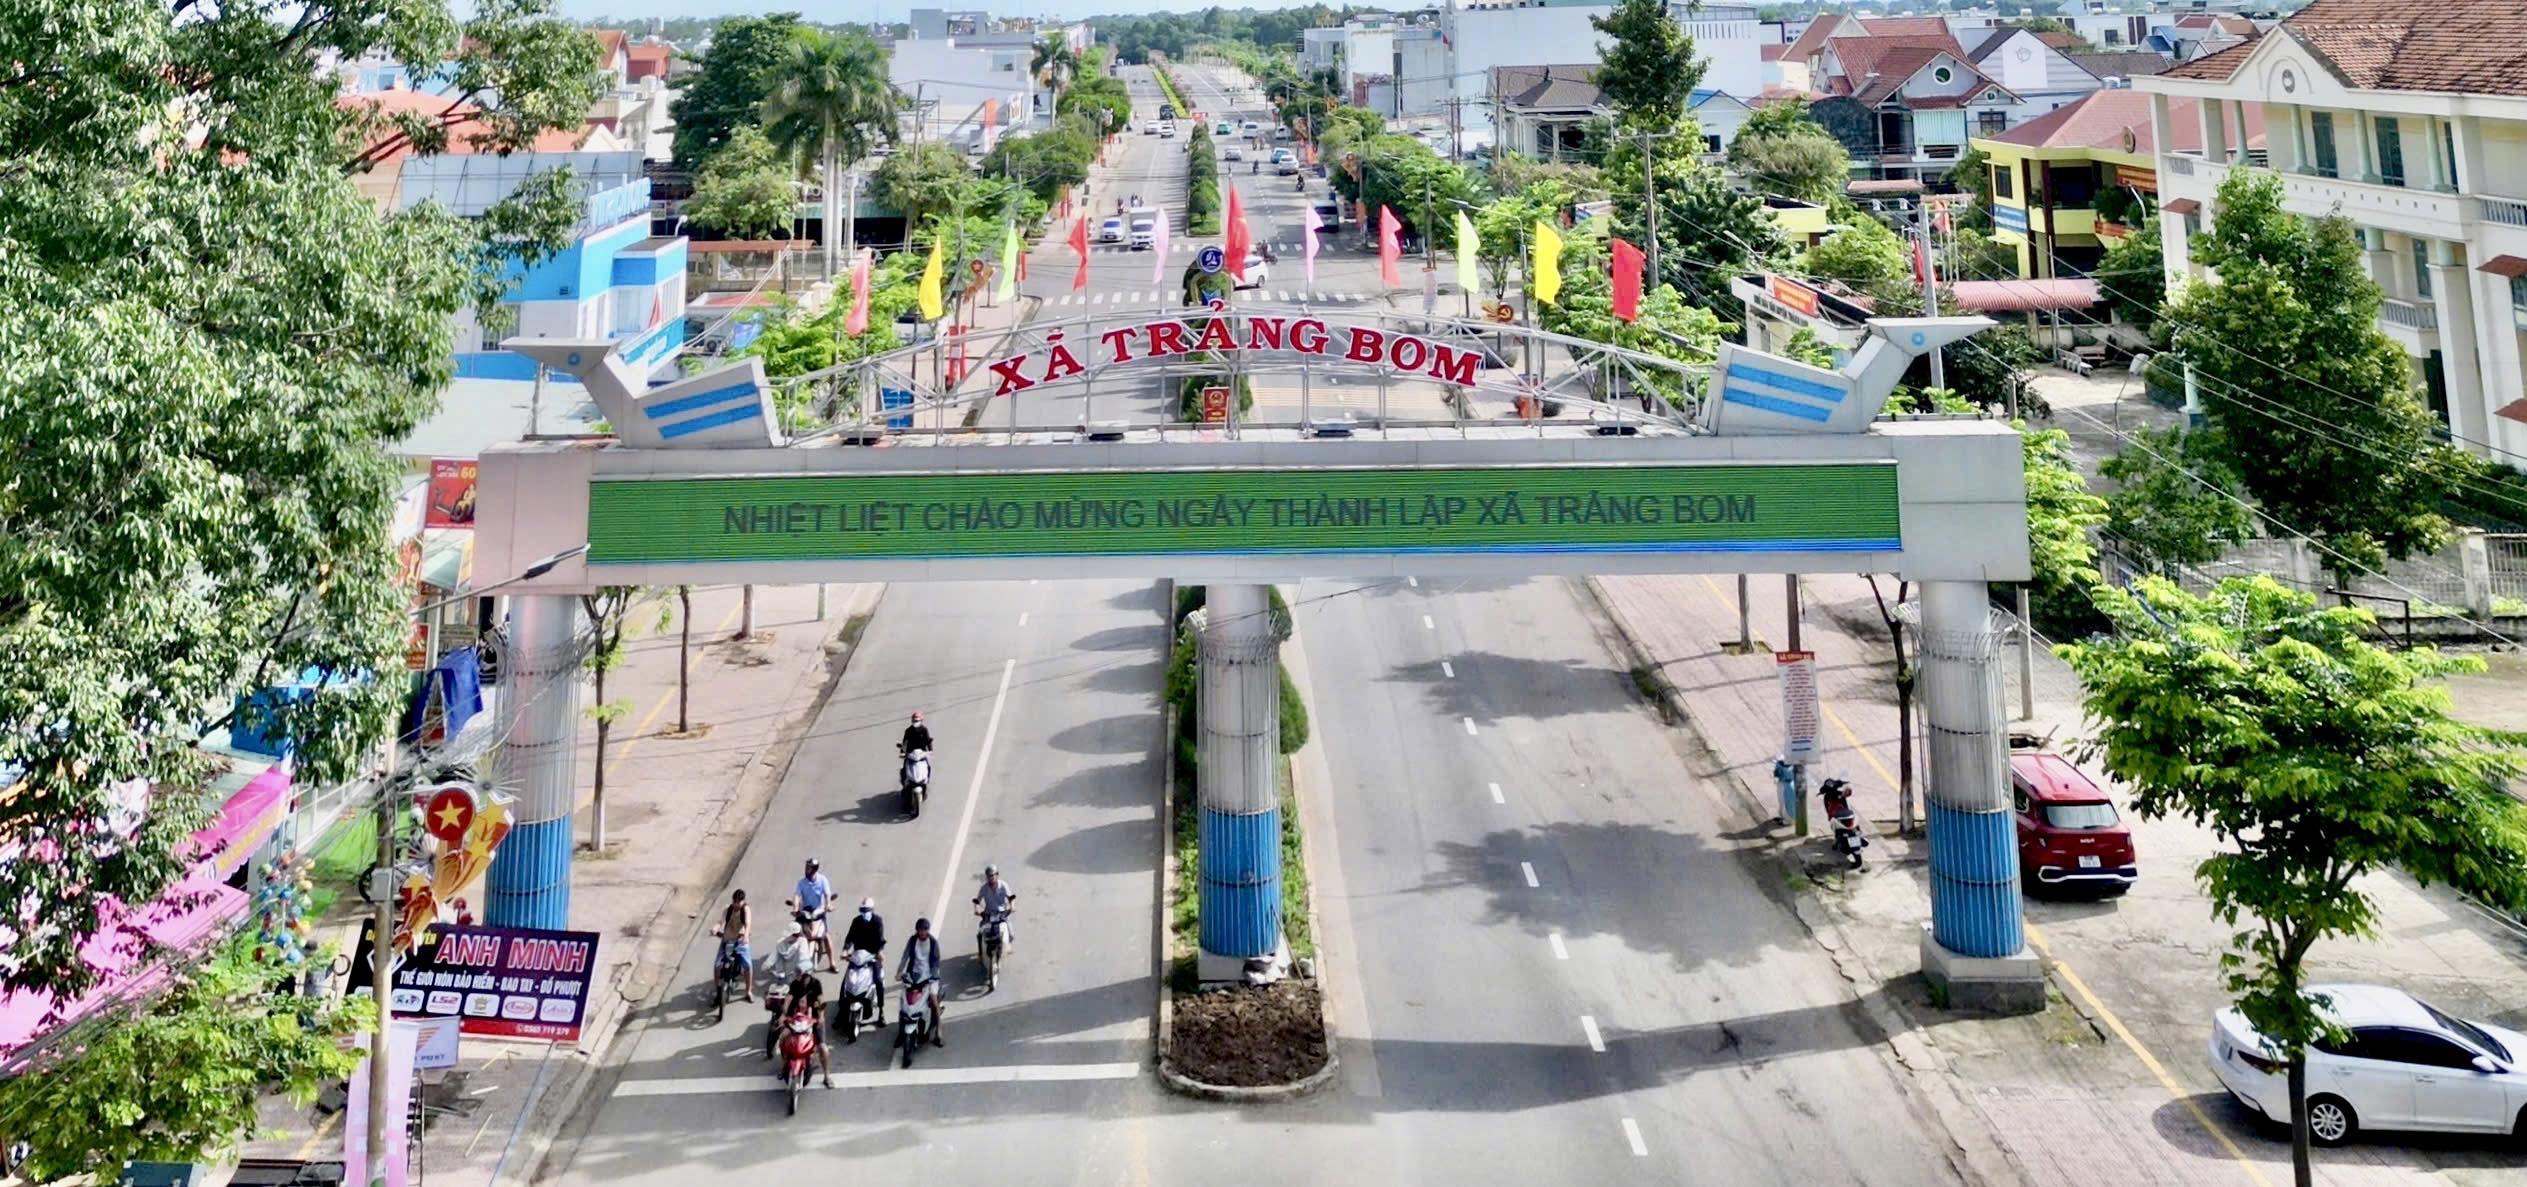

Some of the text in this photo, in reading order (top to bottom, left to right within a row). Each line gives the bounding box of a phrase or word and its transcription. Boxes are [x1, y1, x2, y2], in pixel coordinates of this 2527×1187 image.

[988, 298, 1484, 397] XÃ TRẢNG BOM
[723, 501, 831, 538] NHIỆT
[839, 500, 914, 537] LIỆT
[922, 497, 1023, 531] CHÀO
[1033, 494, 1145, 529] MỪNG
[1266, 492, 1388, 527] THÀNH
[1400, 493, 1467, 530] LẬP
[1476, 490, 1526, 525] XÃ
[1535, 489, 1664, 525] TRẢNG
[1672, 494, 1756, 524] BOM
[434, 933, 502, 967] ANH
[507, 937, 590, 974] MINH
[399, 968, 418, 985] THẾ
[500, 976, 519, 992] BAO
